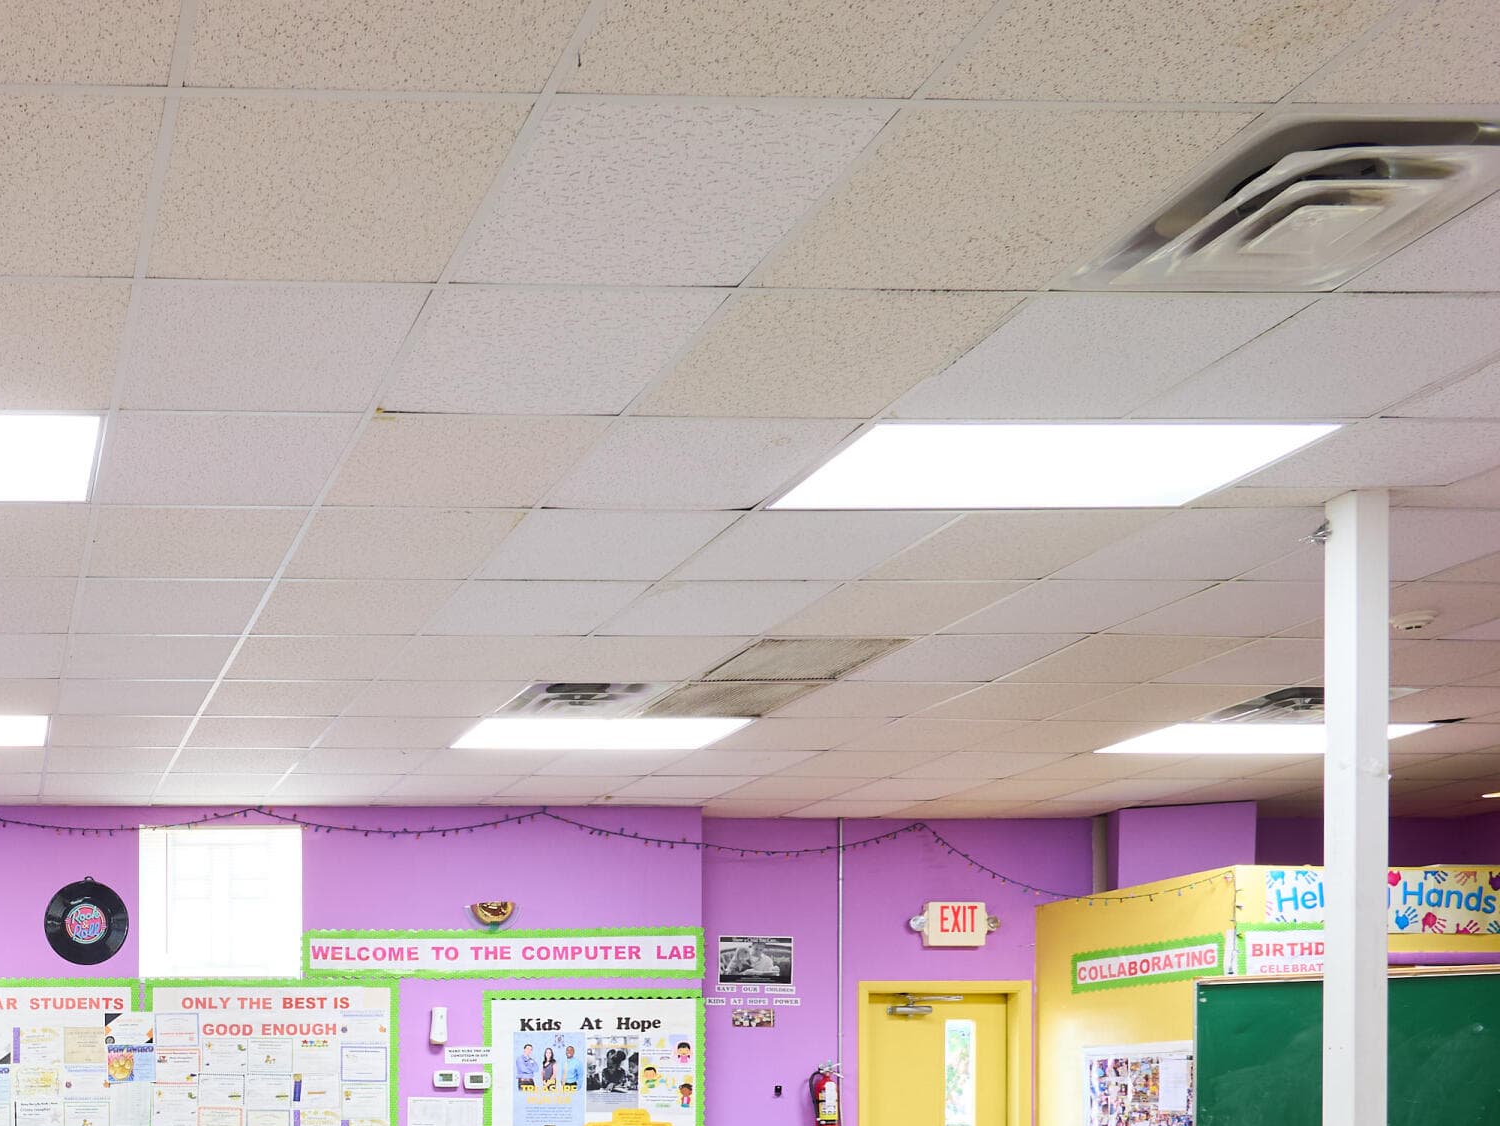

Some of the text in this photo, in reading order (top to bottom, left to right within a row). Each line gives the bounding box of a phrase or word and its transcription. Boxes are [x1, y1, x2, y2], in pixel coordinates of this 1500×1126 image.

[1402, 881, 1497, 914] Hands
[72, 907, 101, 924] Rock
[940, 905, 977, 933] EXIT
[73, 923, 101, 940] Roll
[311, 945, 696, 962] WELCOME TO THE COMPUTER LAB
[1251, 942, 1324, 957] BIRTHD
[1078, 949, 1216, 981] COLLABORATING
[1260, 964, 1323, 975] CELEBRAT
[29, 998, 124, 1010] STUDENTS
[181, 997, 350, 1010] ONLY THE BEST IS
[202, 1023, 338, 1036] GOOD ENOUGH
[519, 1017, 662, 1033] Kids At Hope
